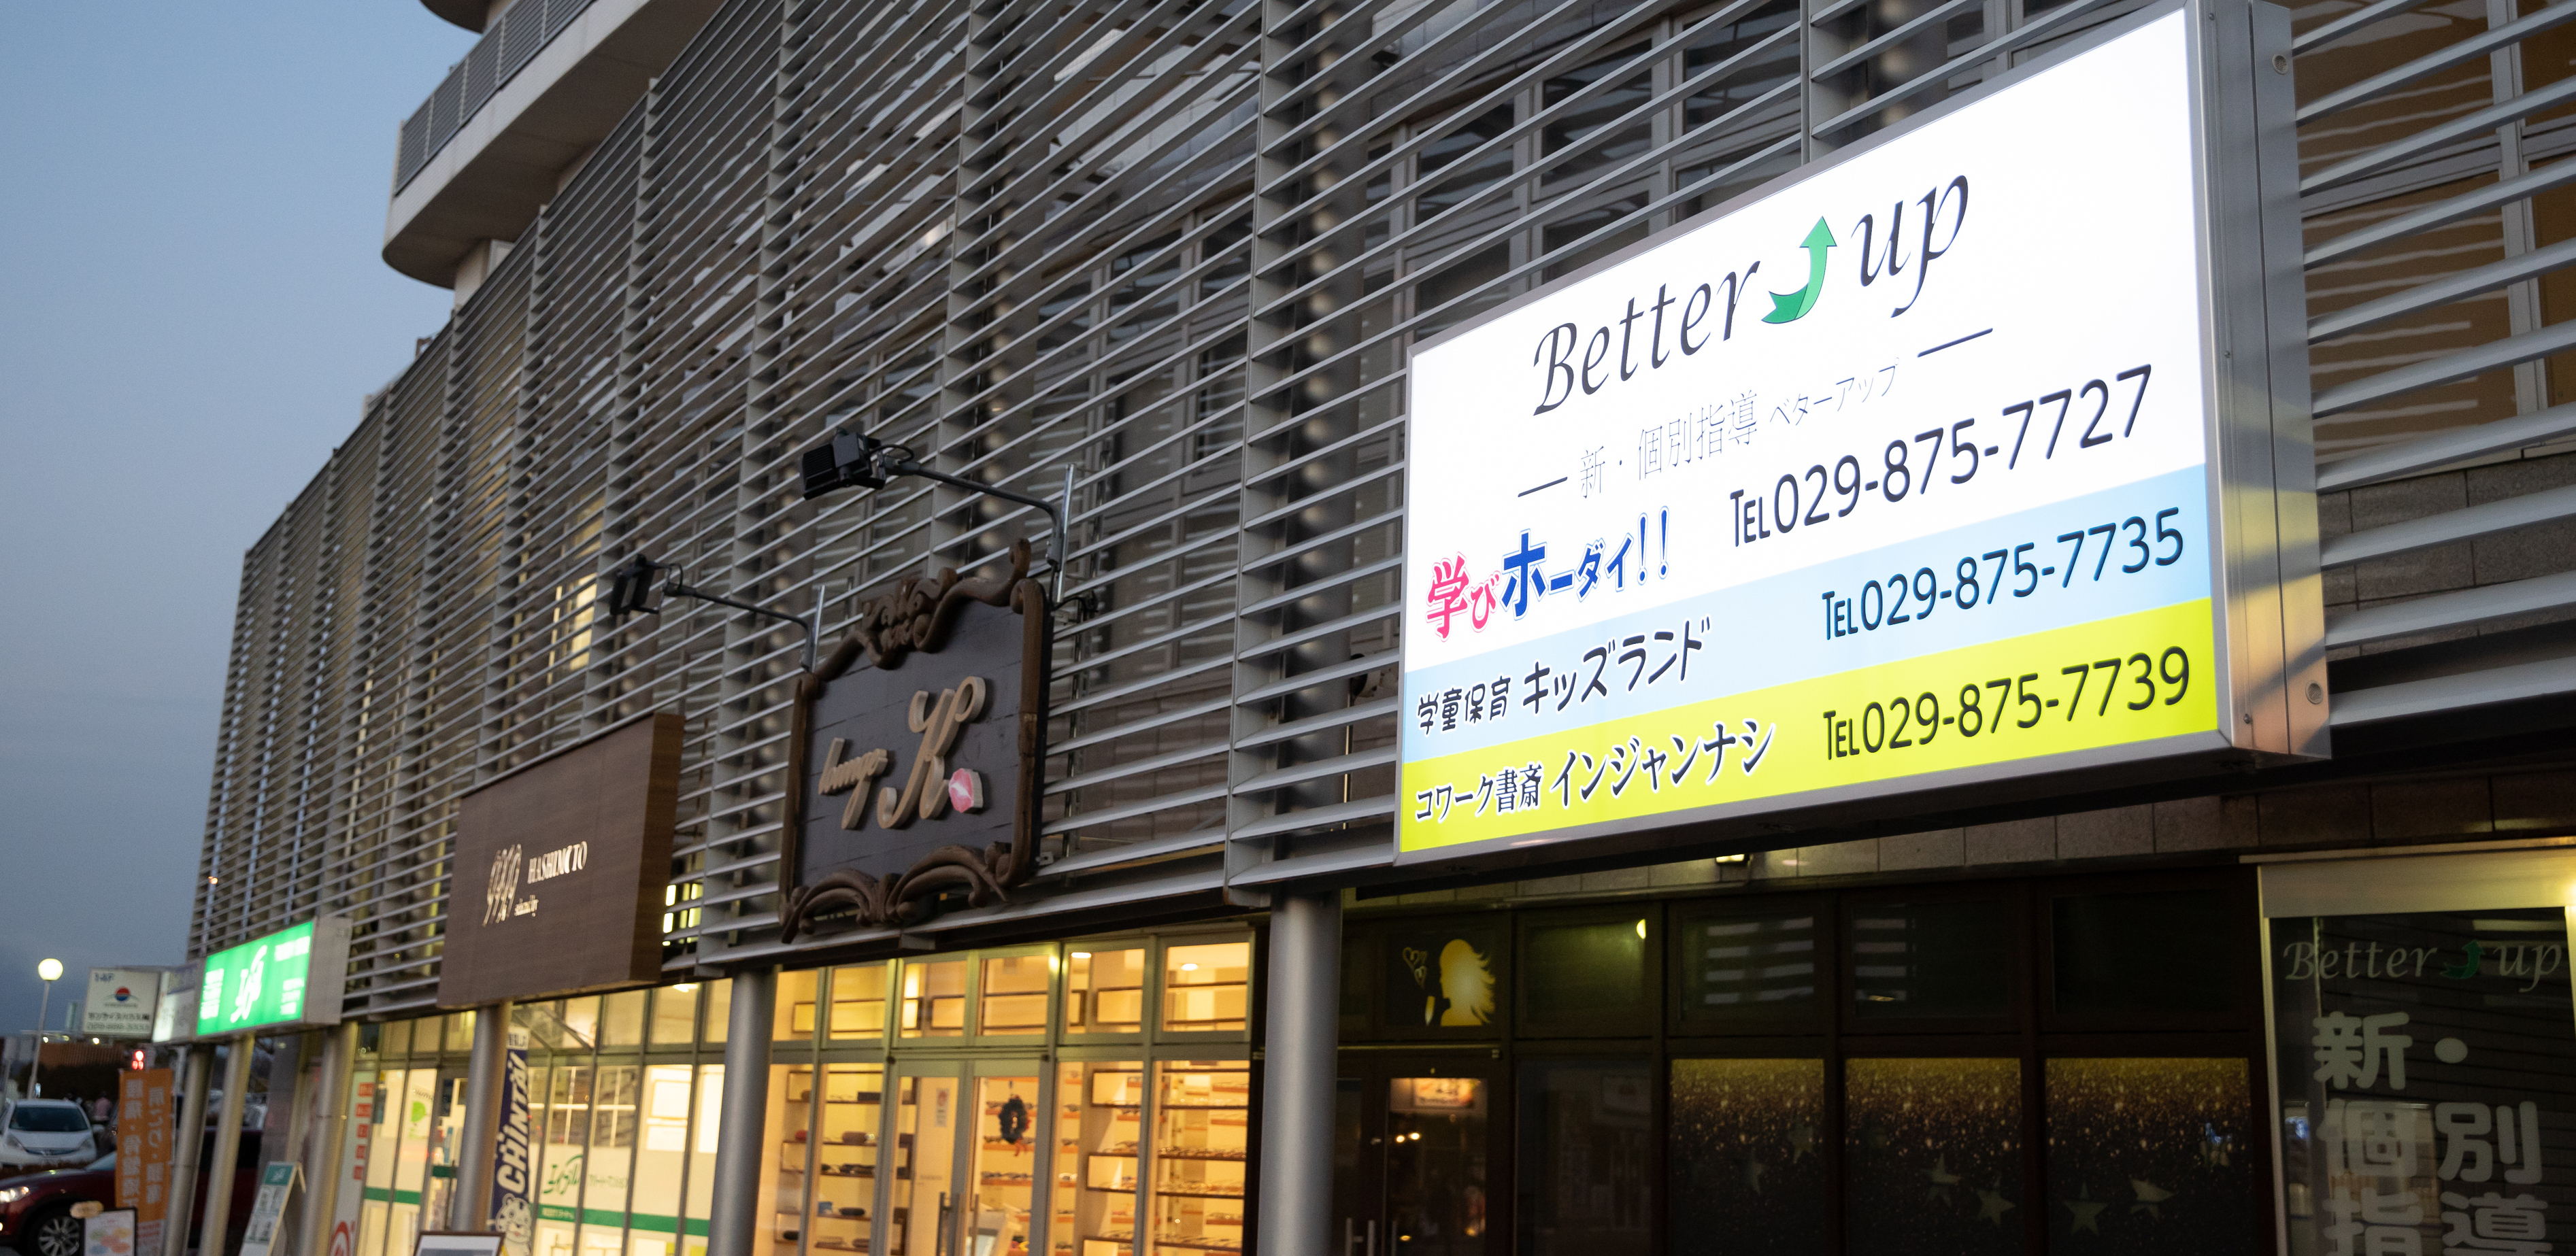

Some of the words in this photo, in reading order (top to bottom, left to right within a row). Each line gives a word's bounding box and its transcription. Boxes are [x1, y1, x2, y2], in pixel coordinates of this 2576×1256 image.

[1533, 258, 1760, 416] Better
[1851, 174, 1970, 318] up
[1579, 389, 1758, 500] 新・個別指導
[1769, 357, 1901, 427] ベターアップ
[1417, 675, 1511, 735] 学童保育
[1522, 616, 1710, 714] キッズランド
[1417, 763, 1543, 821] コワーク書斎
[1550, 719, 1777, 807] インジャンナシ
[2283, 940, 2439, 981] Better
[2492, 943, 2563, 994] up
[2315, 1098, 2543, 1185] 個別
